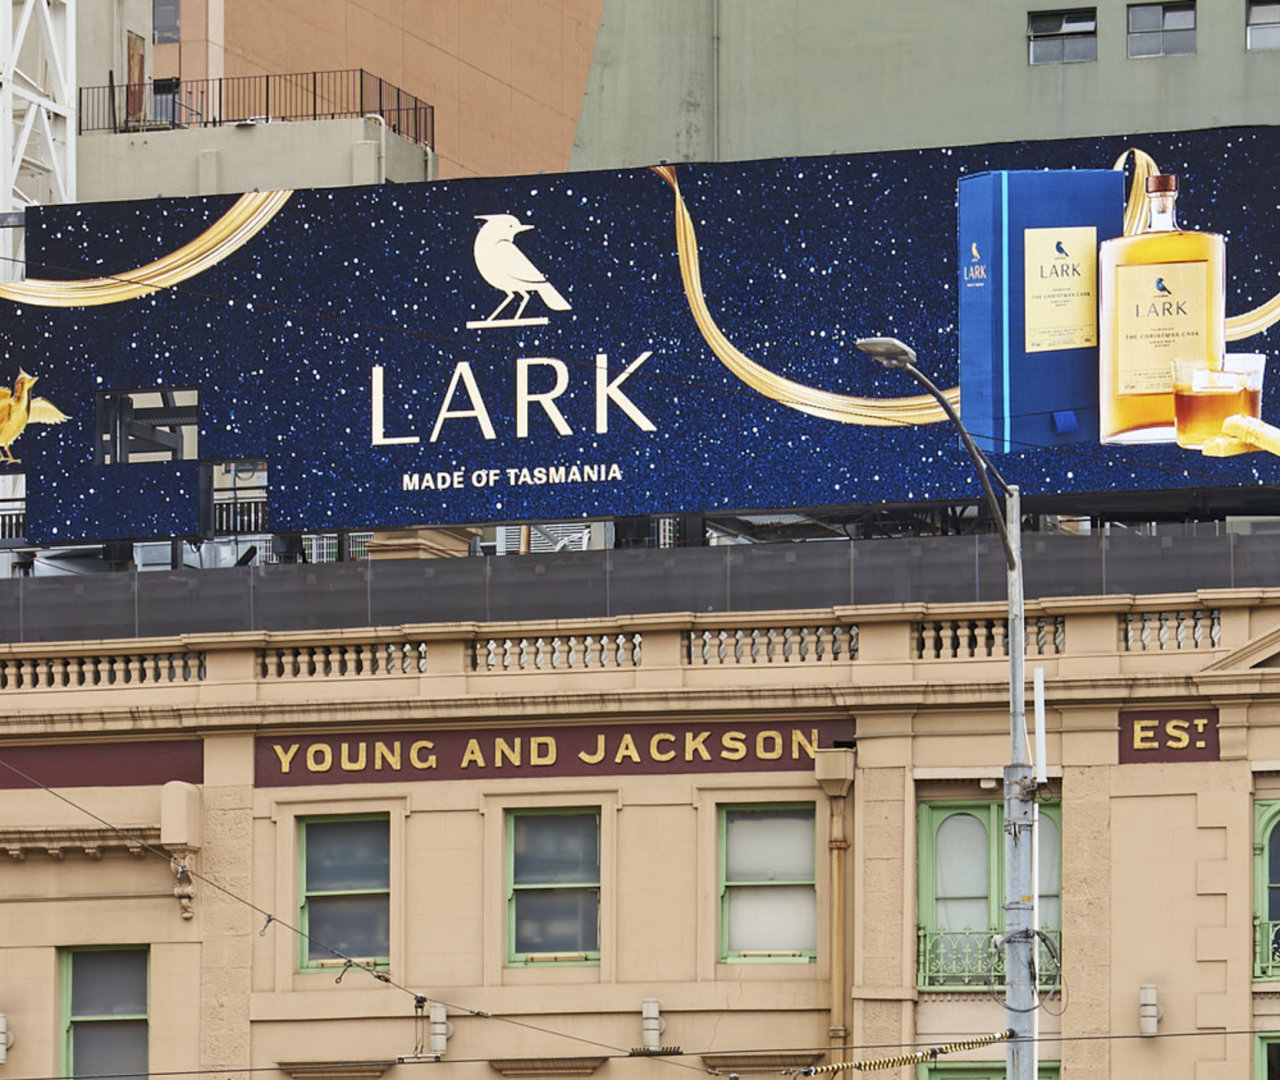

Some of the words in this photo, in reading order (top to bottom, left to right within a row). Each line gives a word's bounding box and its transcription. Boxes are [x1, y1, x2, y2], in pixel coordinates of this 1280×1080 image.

[963, 264, 987, 280] LARK
[1039, 262, 1082, 279] LARK
[1135, 300, 1188, 318] LARK
[371, 350, 658, 447] LARK
[402, 471, 468, 491] MADE
[472, 469, 501, 486] OF
[507, 463, 623, 485] TASMANIA
[273, 740, 437, 774] YOUNG
[461, 735, 557, 769] AND
[578, 729, 819, 764] JACKSON
